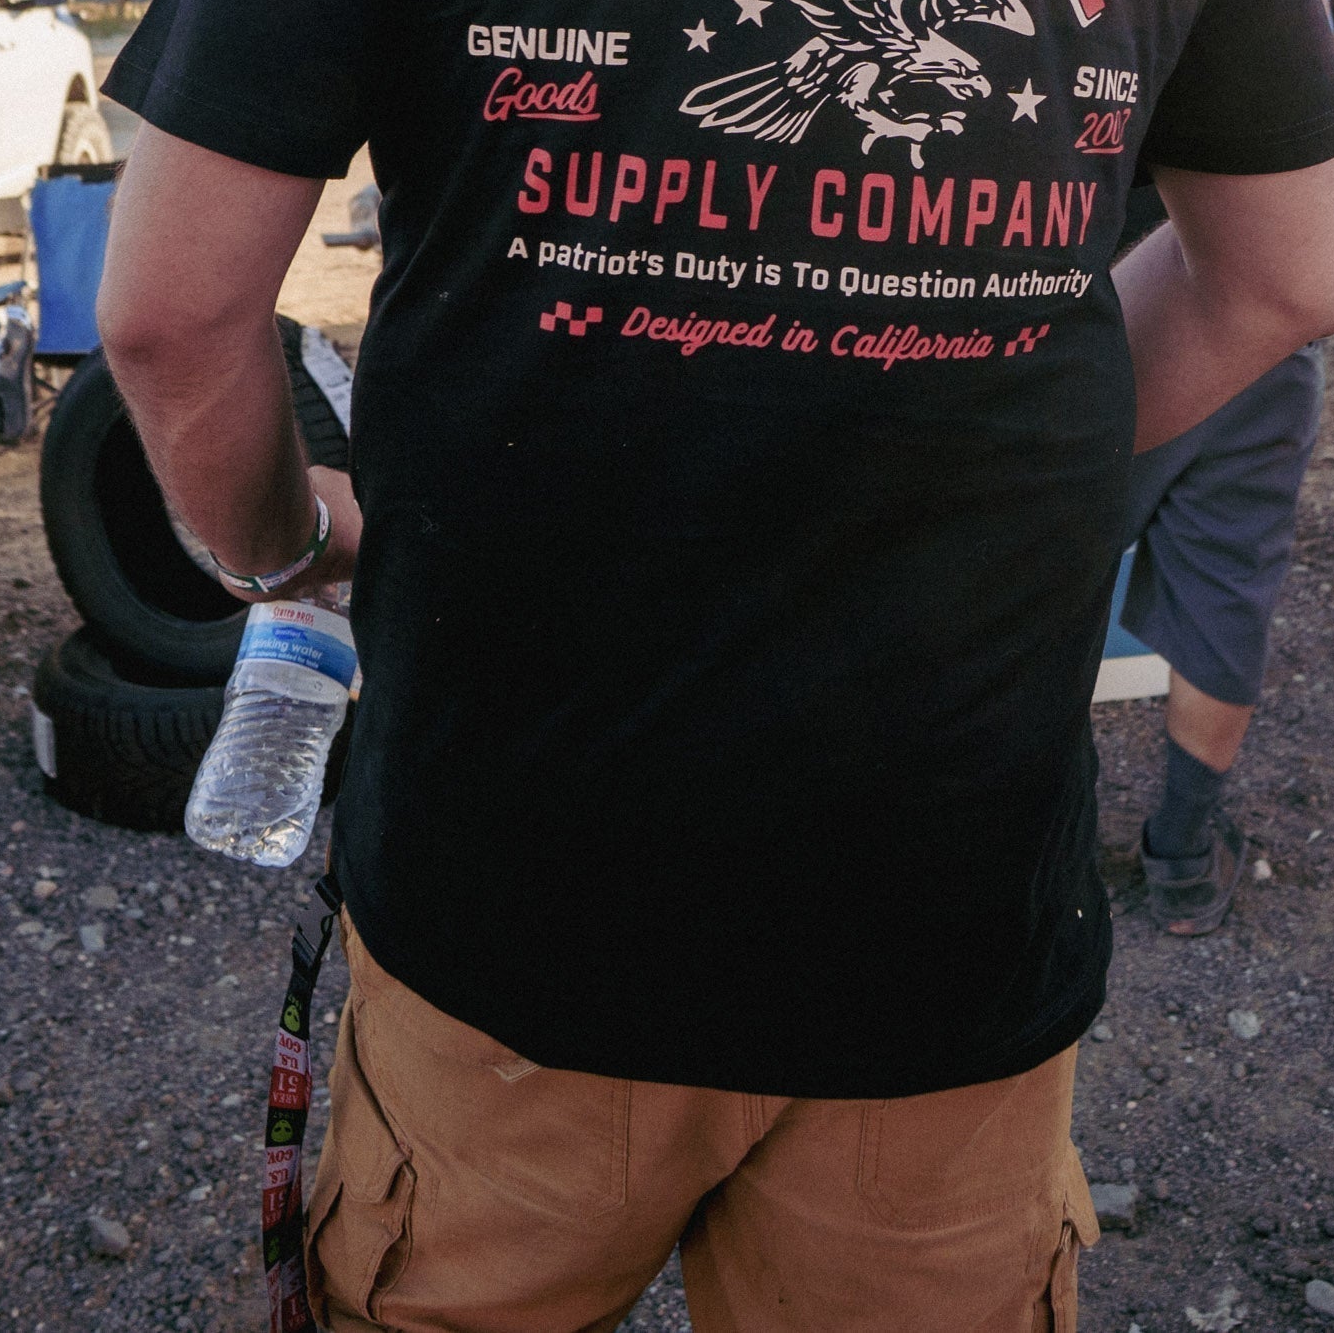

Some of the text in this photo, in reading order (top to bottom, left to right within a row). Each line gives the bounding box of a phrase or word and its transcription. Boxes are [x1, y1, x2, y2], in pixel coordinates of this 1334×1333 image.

[468, 24, 632, 66] GENUINE
[483, 66, 602, 122] Goods
[1073, 65, 1139, 104] SINCE
[517, 147, 1098, 248] SUPPLY COMPANY
[507, 237, 1093, 298] A patriot's Duty is To Question Authority
[620, 306, 995, 371] Designed in California
[291, 643, 323, 660] water
[272, 1091, 298, 1104] AREA
[277, 1073, 299, 1093] 51
